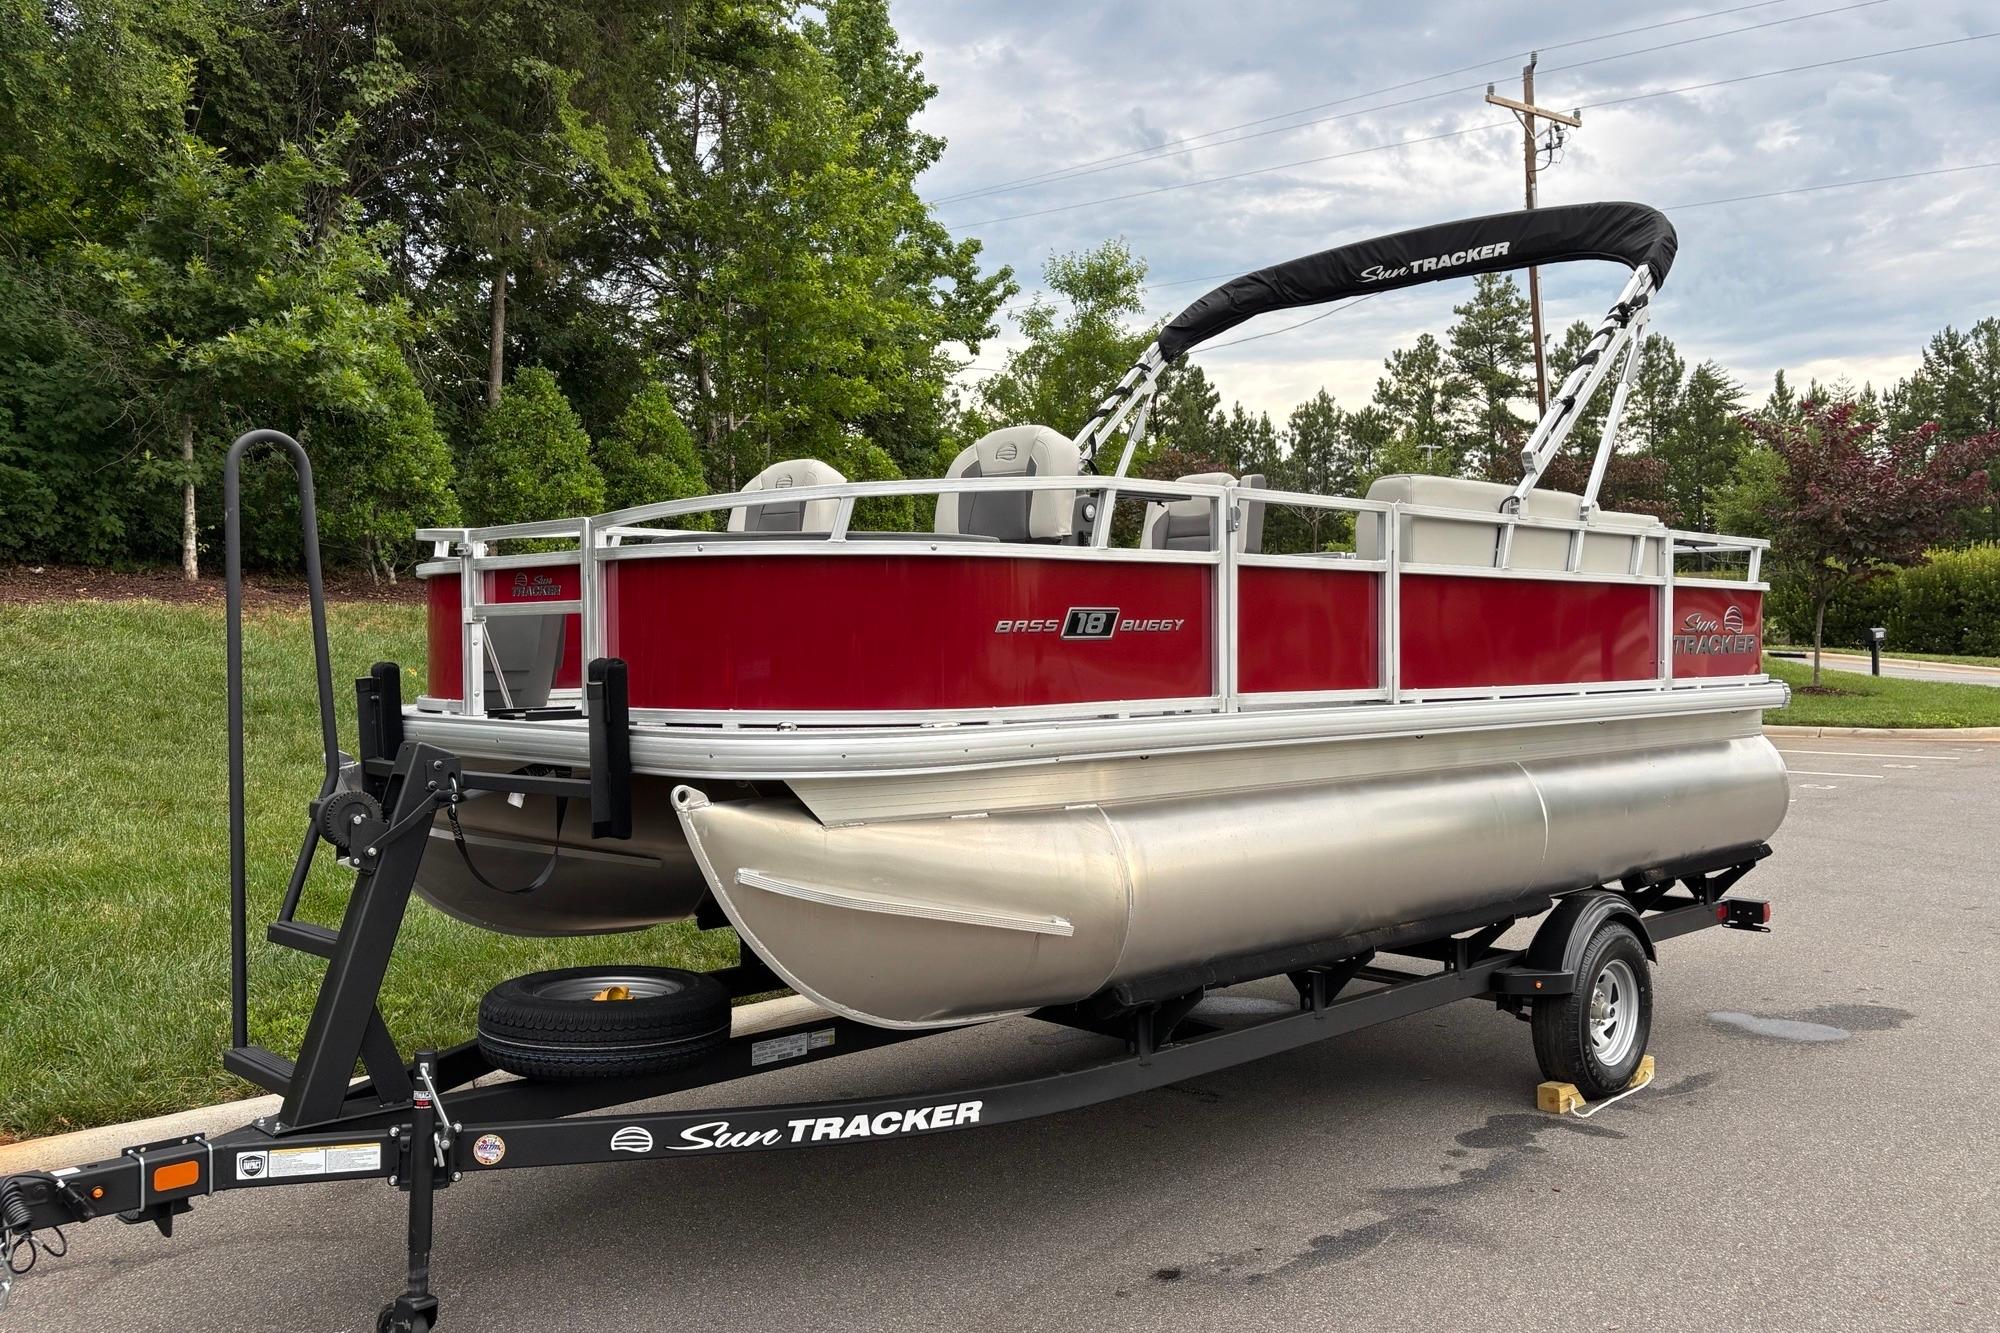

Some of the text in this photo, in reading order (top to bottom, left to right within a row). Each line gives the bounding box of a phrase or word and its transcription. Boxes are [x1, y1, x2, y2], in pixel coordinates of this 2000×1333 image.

[1356, 241, 1510, 283] Sun TRACKER
[512, 585, 561, 596] TRACKER
[995, 612, 1185, 634] BASS 18 BUGGY
[1680, 612, 1719, 632] Sun
[1673, 634, 1756, 655] TRACKER
[665, 1100, 983, 1150] Sun TRACKER
